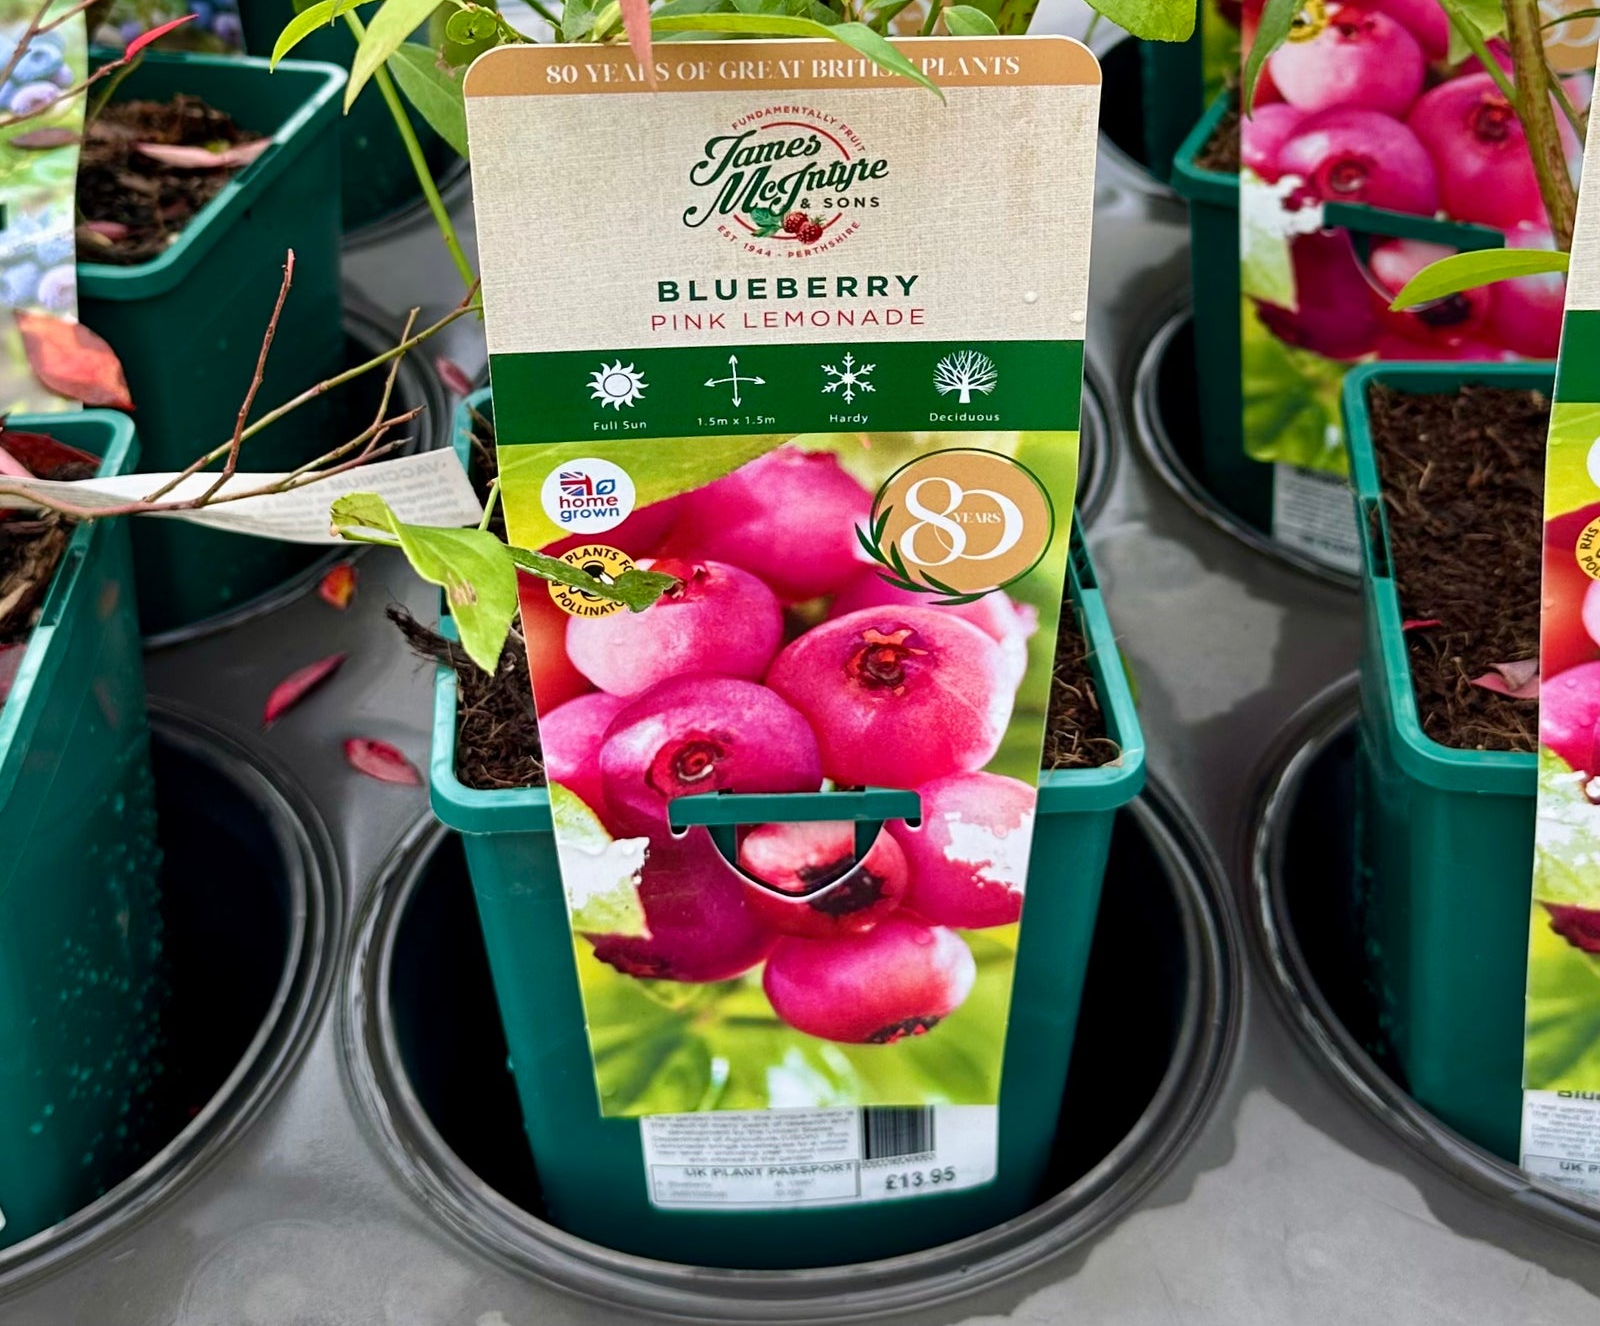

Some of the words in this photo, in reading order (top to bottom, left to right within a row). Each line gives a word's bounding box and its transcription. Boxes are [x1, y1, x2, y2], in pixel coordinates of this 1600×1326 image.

[546, 64, 578, 84] 80
[676, 61, 712, 81] OF
[719, 60, 805, 80] GREAT
[812, 58, 913, 78] BRITI
[922, 56, 1020, 77] PLANTS
[731, 105, 837, 131] FUNDAMENTALLY
[838, 124, 866, 152] FRUIT
[690, 130, 822, 186] James
[683, 158, 890, 227] McIntyre
[800, 197, 811, 209] &
[824, 196, 880, 208] SONS
[716, 225, 738, 243] EST
[743, 241, 772, 258] 1944
[787, 221, 861, 258] PERTHSHIRE
[657, 275, 919, 302] BLUEBERRY
[651, 312, 726, 331] PINK
[743, 308, 925, 329] LEMONADE
[593, 420, 618, 431] Full
[623, 419, 647, 430] Sun
[697, 417, 728, 426] 1.5m
[745, 415, 776, 425] 1.5m
[829, 413, 869, 425] Hardy
[929, 412, 1000, 423] Deciduous
[559, 496, 619, 509] home
[560, 507, 620, 522] grown
[900, 477, 1024, 566] 80
[953, 512, 1001, 524] YEARS
[1579, 527, 1600, 550] RHS
[565, 547, 620, 564] PLANTS
[619, 558, 635, 573] FO
[555, 592, 625, 616] POLLINATO
[683, 1166, 707, 1177] UK
[711, 1165, 762, 1177] PLANT
[767, 1161, 852, 1176] PASSPORT
[885, 1164, 957, 1190] £13.95
